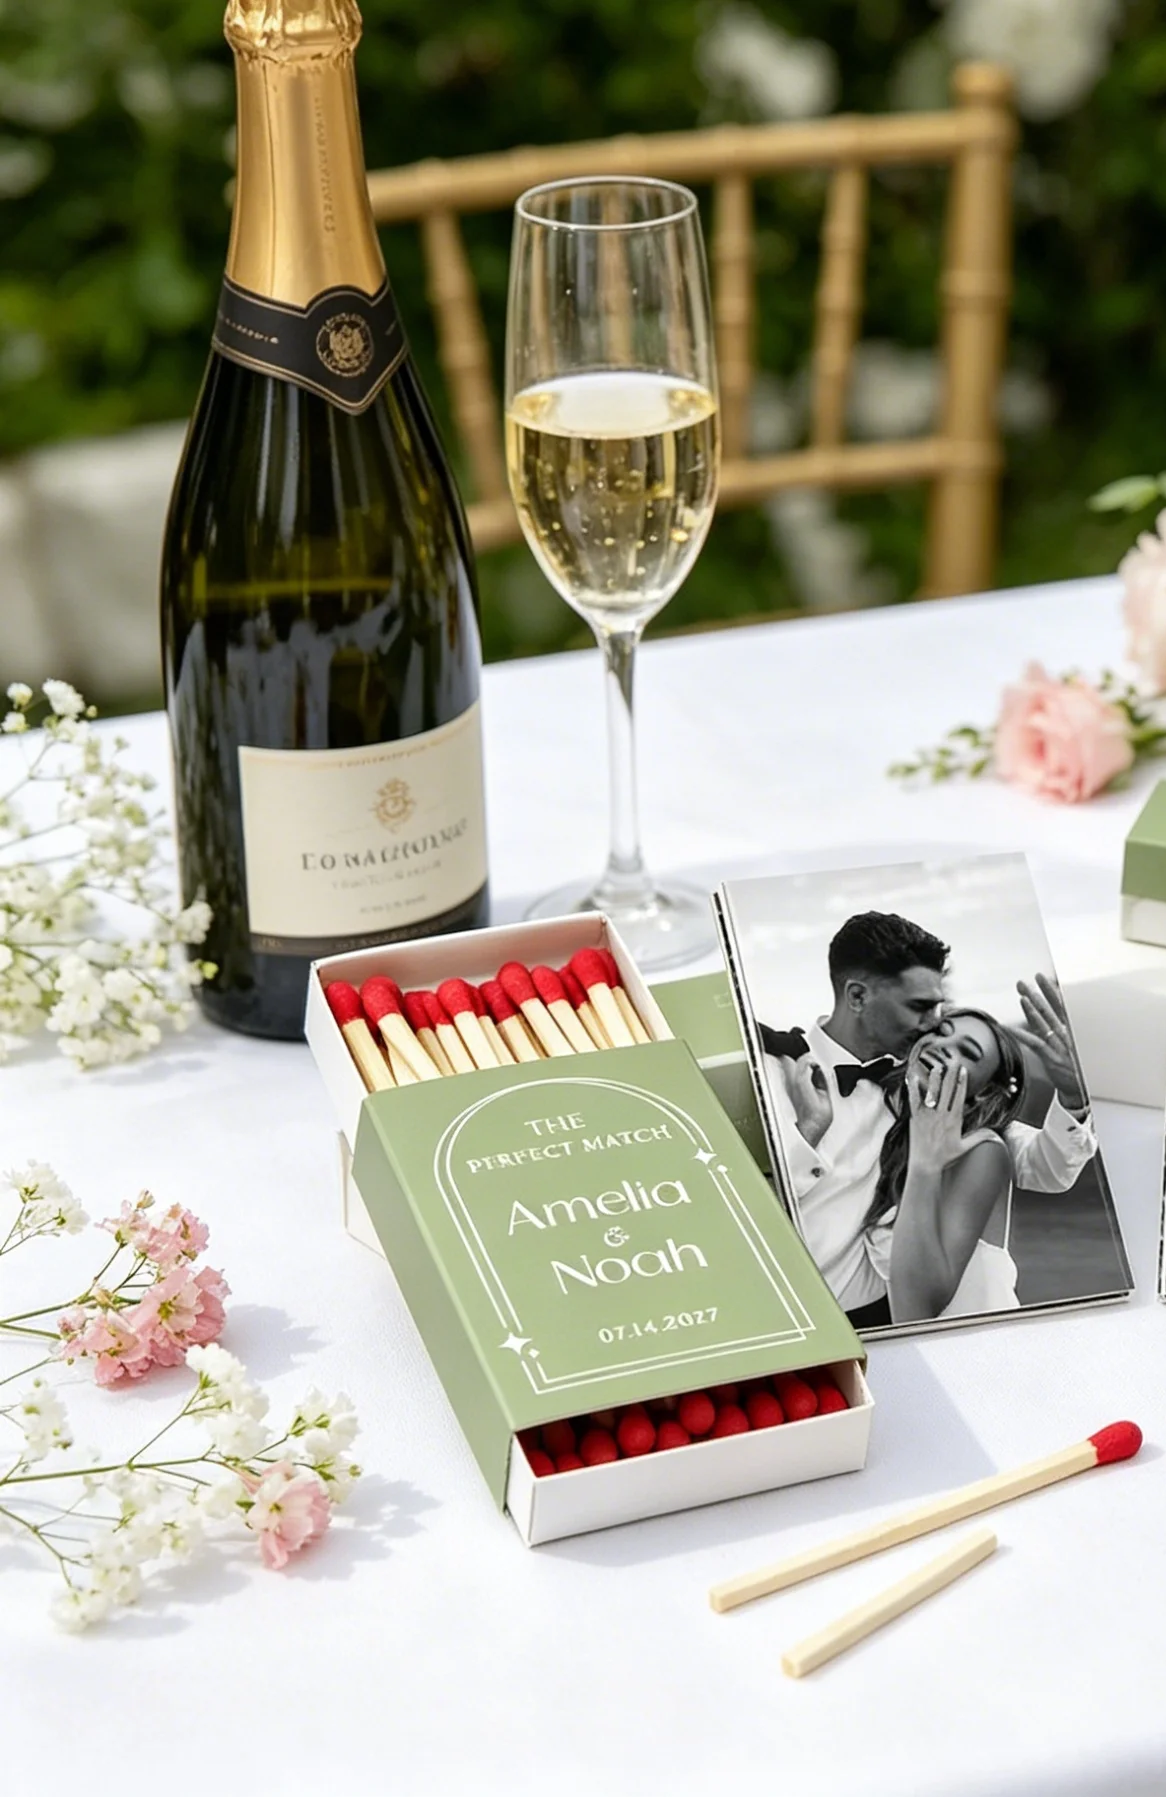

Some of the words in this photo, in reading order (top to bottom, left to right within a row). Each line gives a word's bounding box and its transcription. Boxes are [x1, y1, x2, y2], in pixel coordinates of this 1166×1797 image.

[523, 1112, 586, 1136] THE
[466, 1141, 573, 1174] PERFECT
[582, 1123, 673, 1153] MATCH
[508, 1180, 692, 1236] Amelia
[603, 1225, 630, 1248] &
[550, 1238, 709, 1295] Noah
[598, 1306, 719, 1344] 07.14.2027
